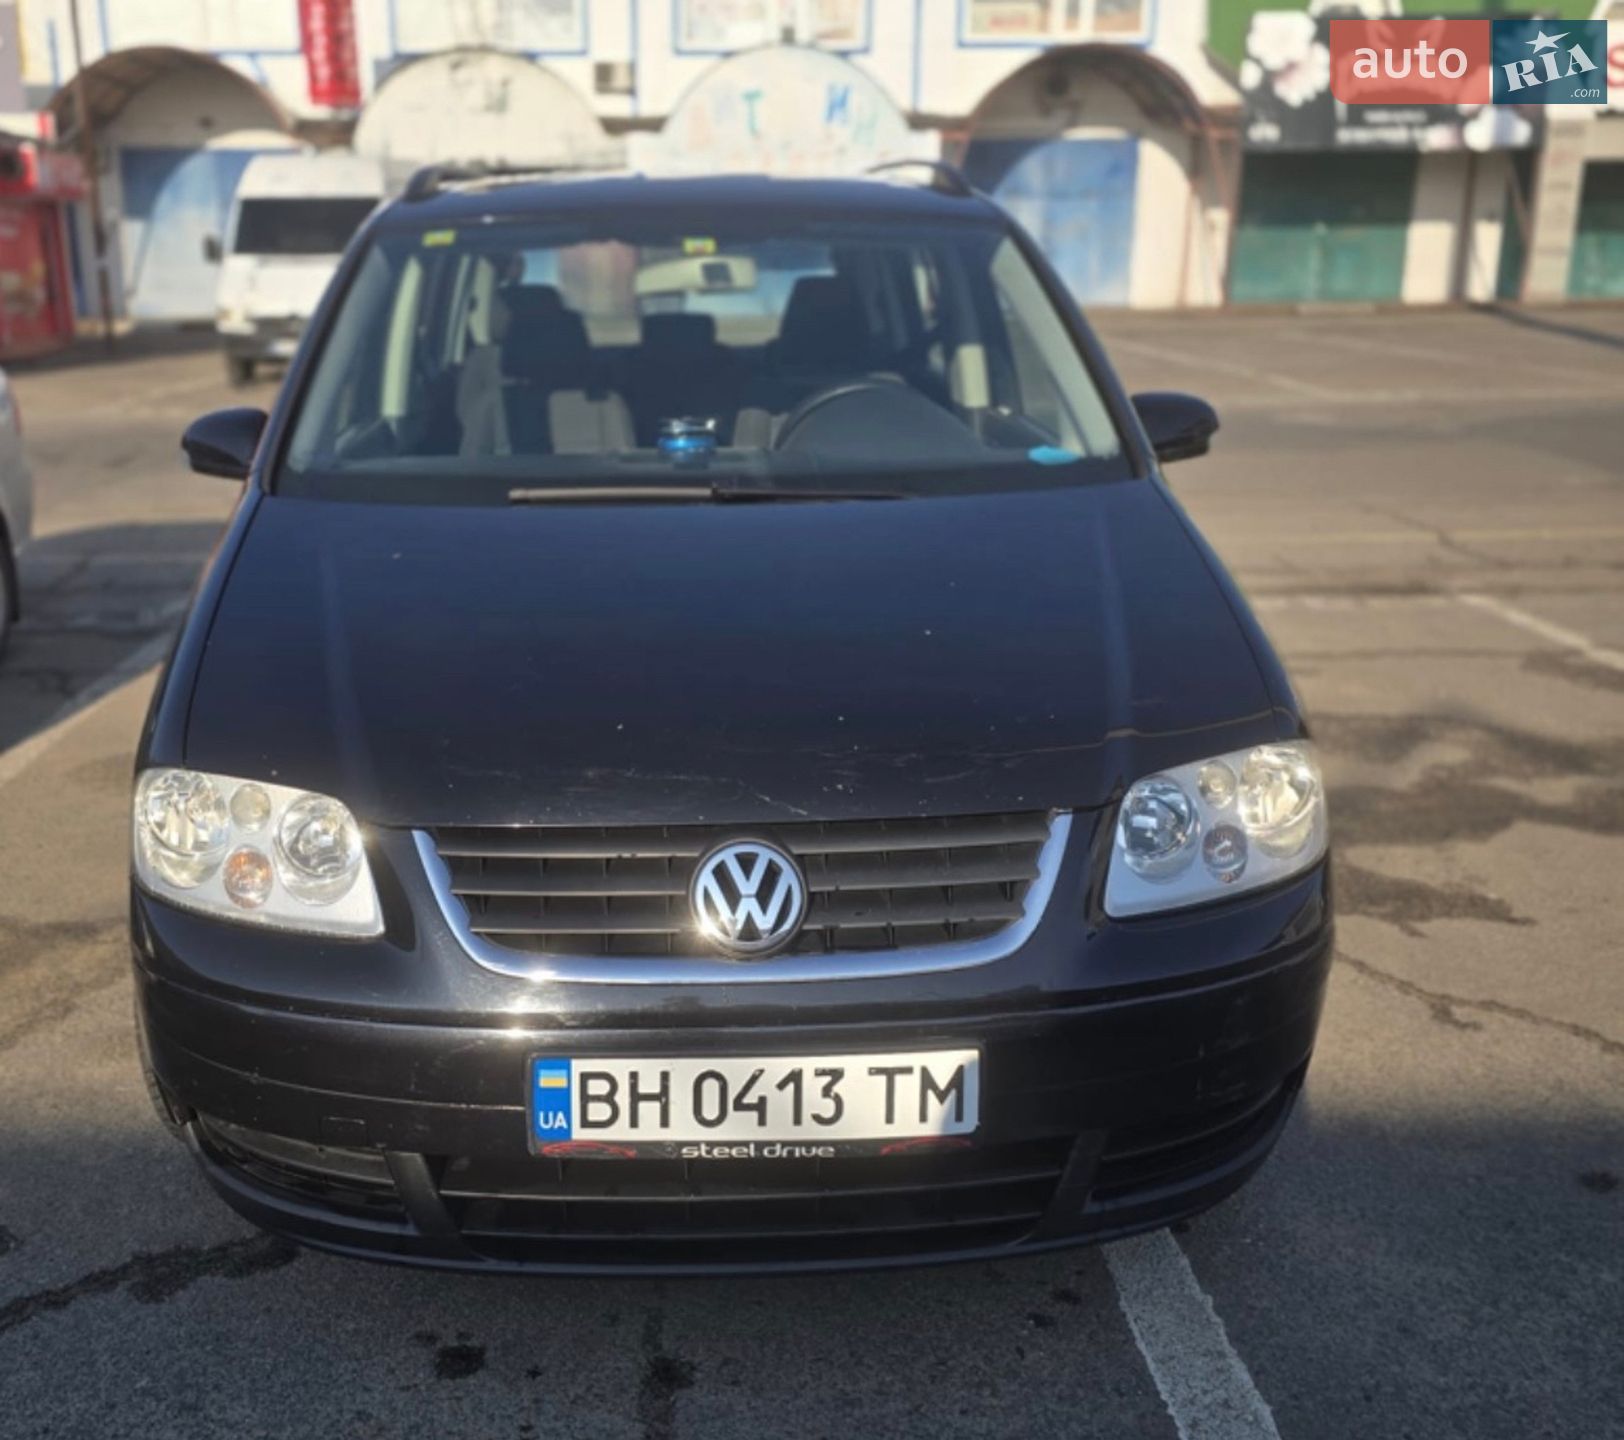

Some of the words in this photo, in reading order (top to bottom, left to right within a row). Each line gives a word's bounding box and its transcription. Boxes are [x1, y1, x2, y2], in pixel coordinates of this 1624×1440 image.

[579, 1070, 671, 1129] BH
[692, 1067, 845, 1128] 0413
[867, 1064, 965, 1125] TM
[538, 1111, 568, 1130] UA
[681, 1142, 756, 1159] steel
[762, 1142, 836, 1159] drive
